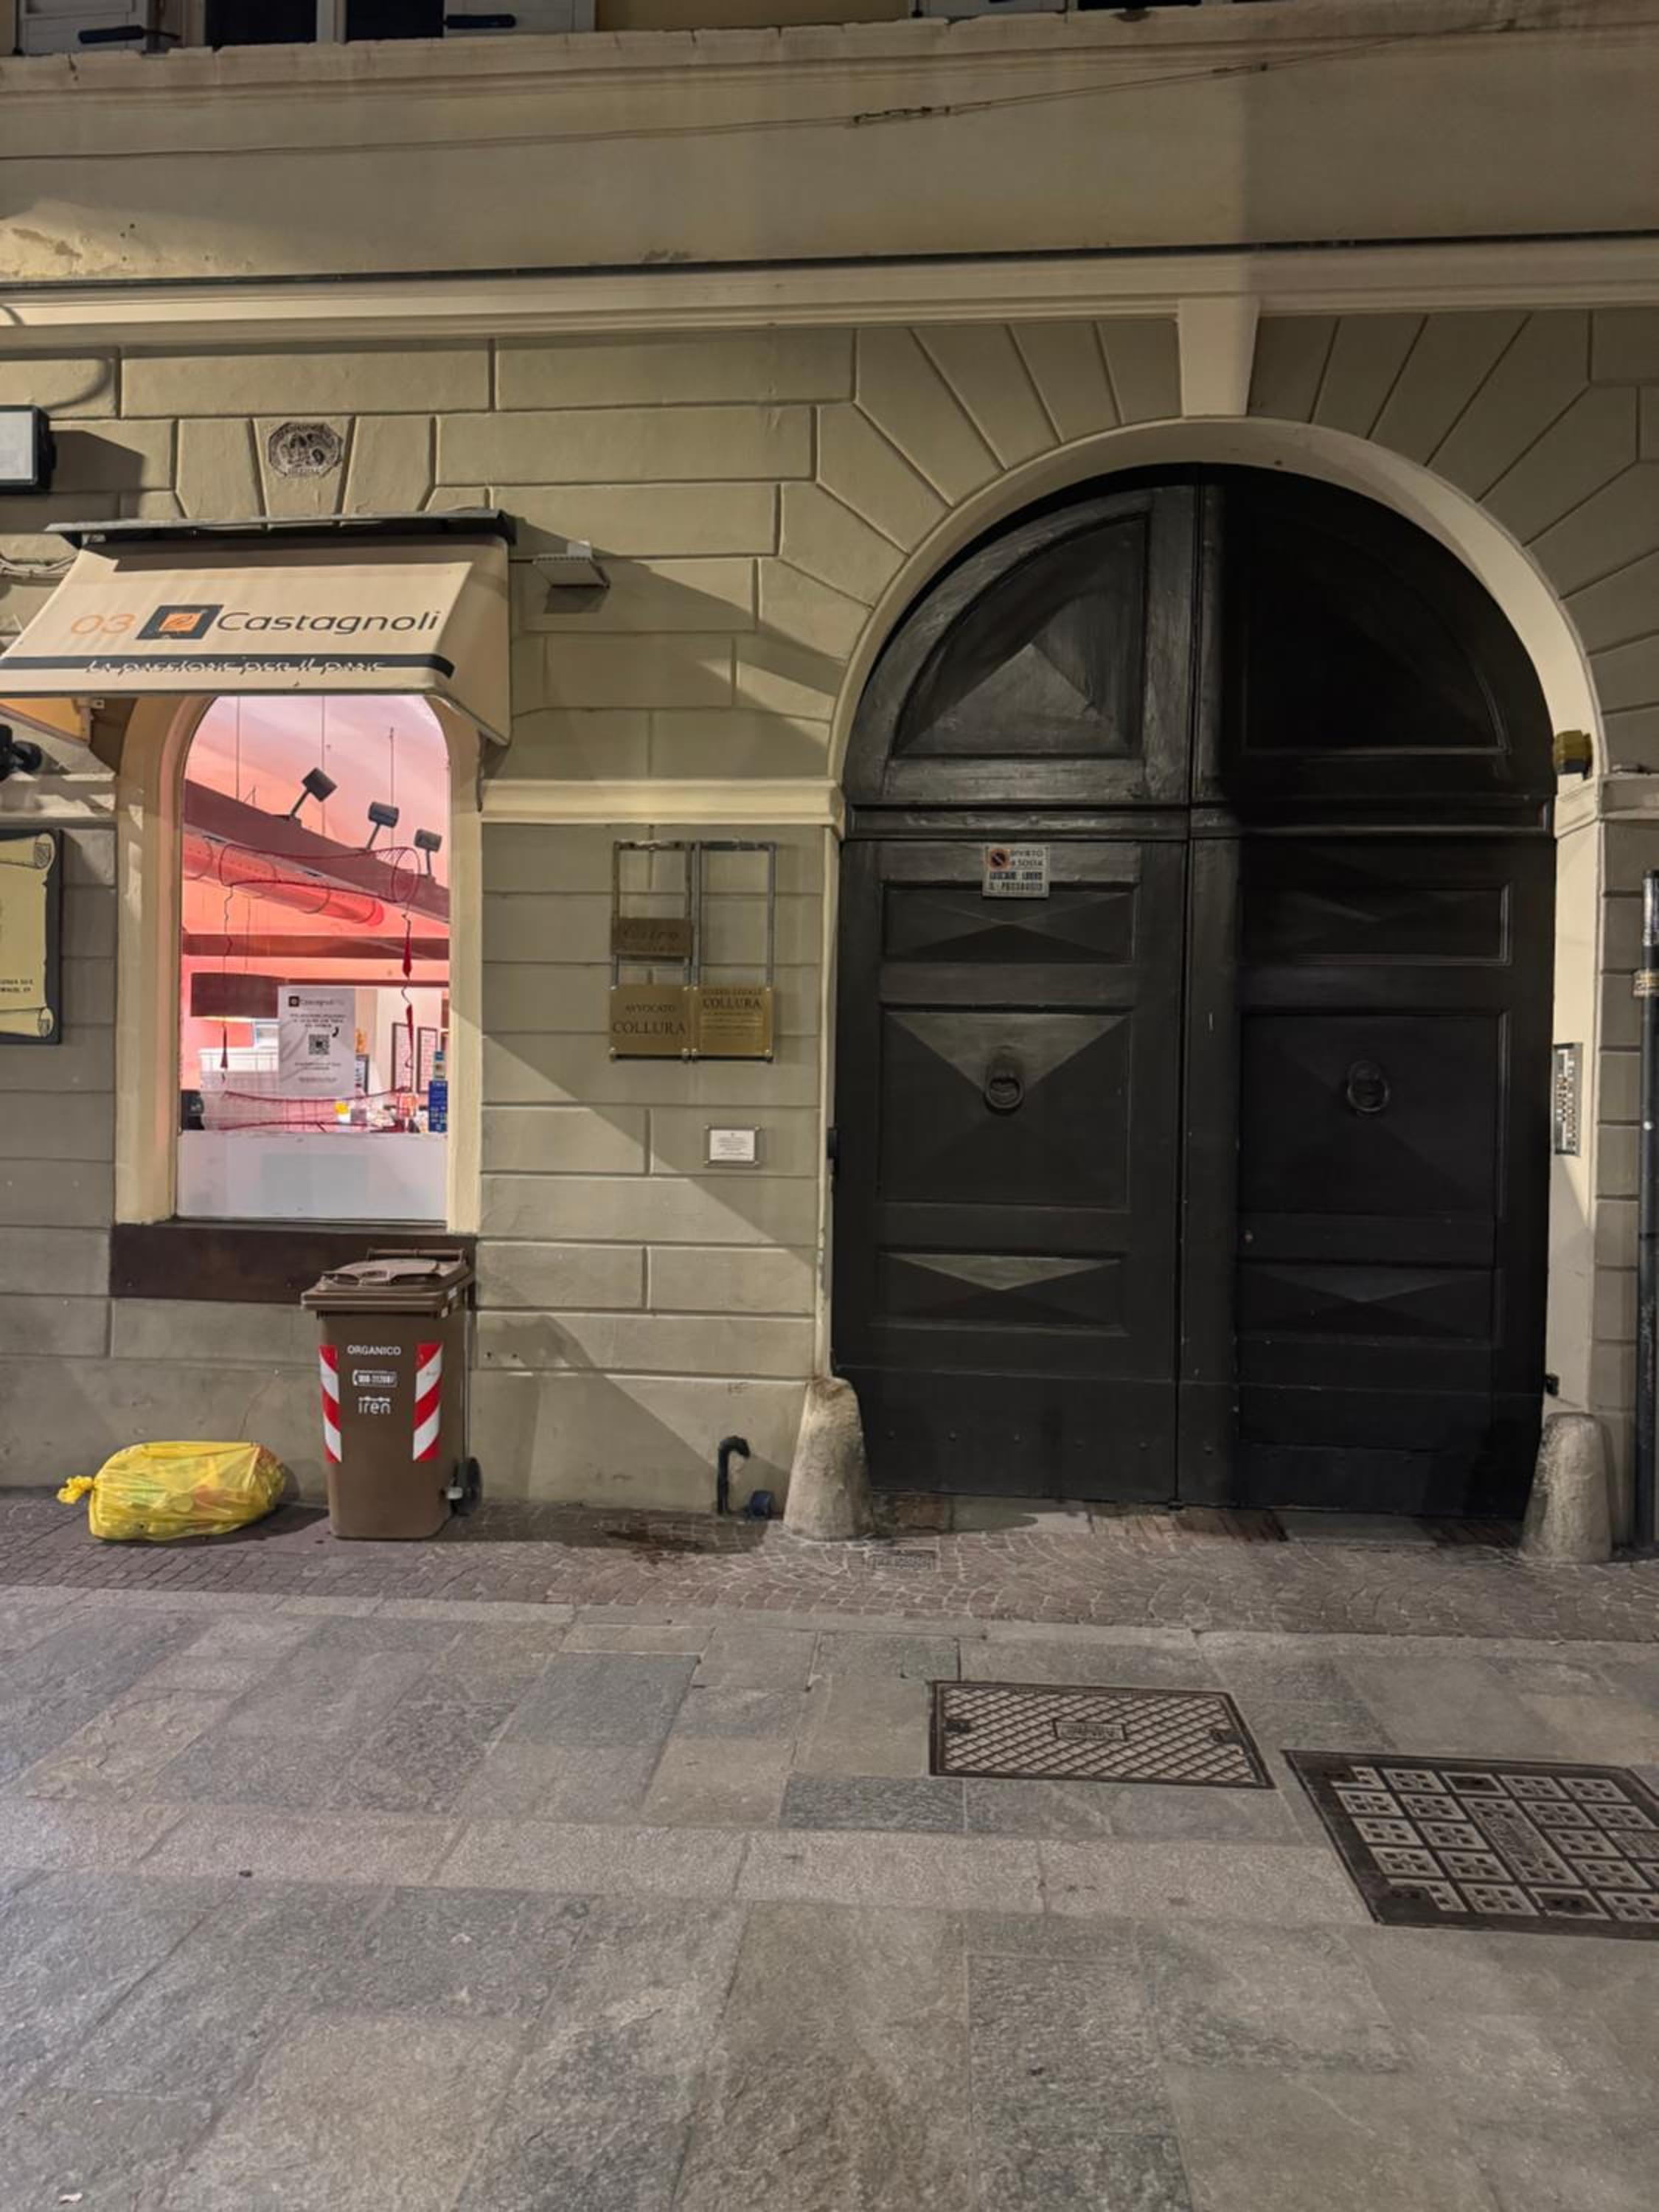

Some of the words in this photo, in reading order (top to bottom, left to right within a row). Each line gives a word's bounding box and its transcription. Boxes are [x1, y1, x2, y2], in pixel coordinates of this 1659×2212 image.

[70, 613, 136, 635] 03
[218, 611, 441, 635] Castagnoli
[702, 997, 762, 1009] COLLURA
[613, 1020, 686, 1034] COLLURA
[347, 1345, 402, 1356] ORGANICO
[358, 1399, 391, 1415] iren
